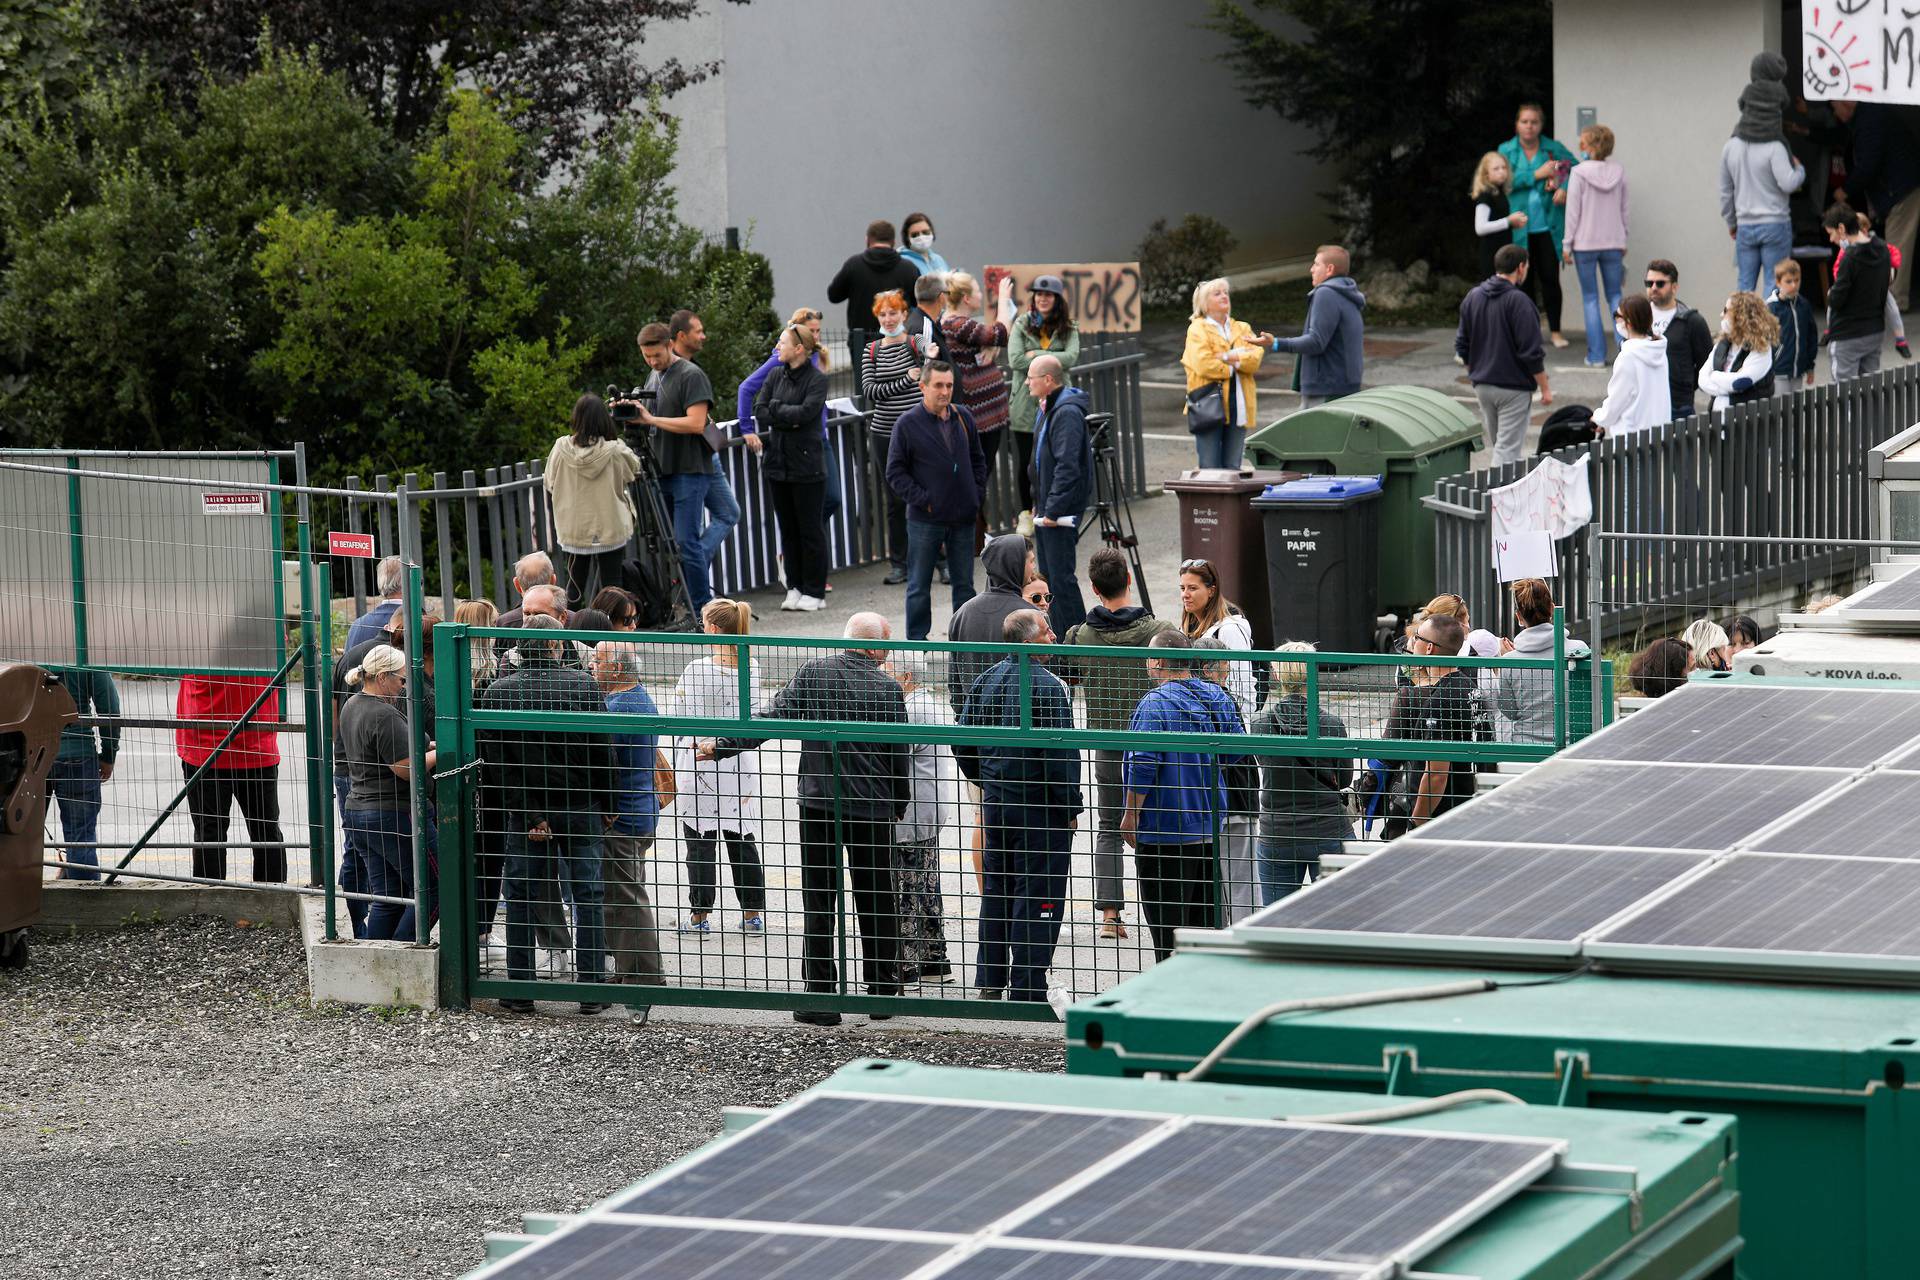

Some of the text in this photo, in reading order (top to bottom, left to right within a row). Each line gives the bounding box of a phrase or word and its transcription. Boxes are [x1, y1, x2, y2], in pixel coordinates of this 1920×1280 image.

[1883, 26, 1920, 91] M
[339, 540, 370, 549] BETAFENCE
[1287, 541, 1316, 551] PAPIR
[1825, 669, 1902, 680] KOVA d.o.o.
